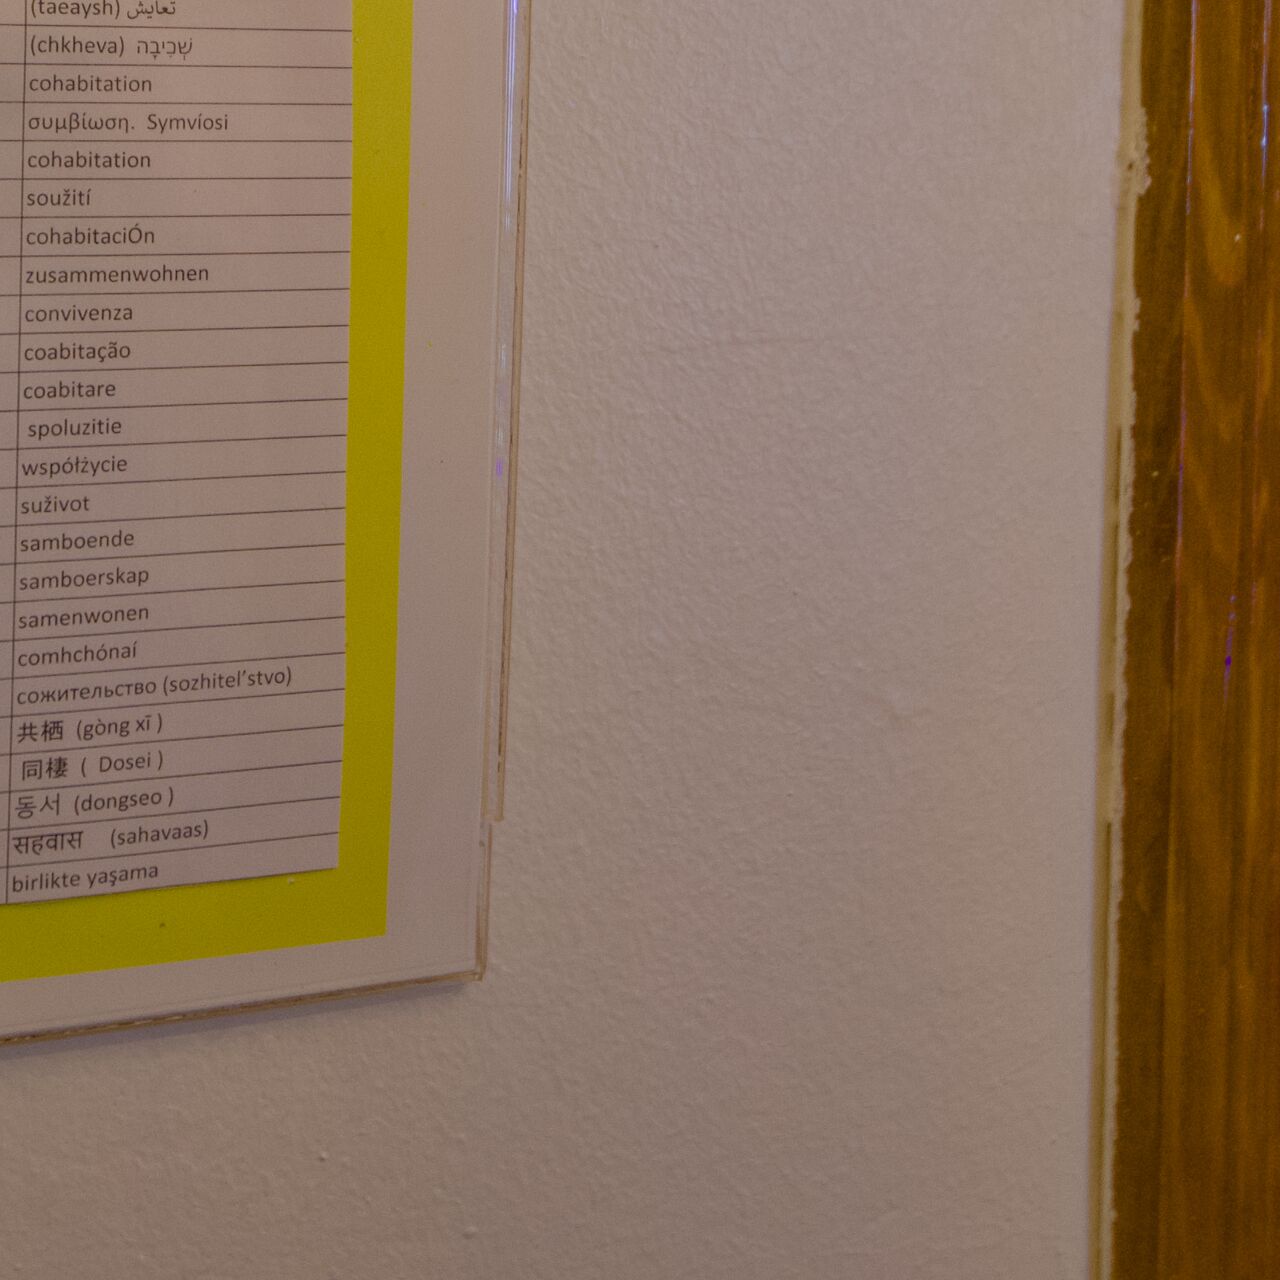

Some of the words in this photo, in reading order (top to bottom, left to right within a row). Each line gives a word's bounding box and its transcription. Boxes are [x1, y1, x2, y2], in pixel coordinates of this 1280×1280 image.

[127, 0, 175, 19] تعايش
[31, 35, 124, 57] (chkheva)
[30, 74, 151, 92] cohabitation
[147, 113, 227, 134] Symvíosi
[28, 151, 150, 168] cohabitation
[27, 189, 91, 206] soužití
[27, 224, 154, 245] cohabitaciÓn
[26, 265, 208, 283] zusammenwohnen
[25, 305, 132, 322] convivenza
[25, 342, 130, 363] coabitação
[24, 381, 115, 399] coabitare
[28, 418, 121, 440] spoluzitie
[22, 456, 127, 478] współżycie
[21, 496, 89, 514] suživot
[21, 530, 134, 552] samboende
[20, 567, 149, 590] samboerskap
[19, 608, 148, 629] samenwonen
[18, 641, 137, 666] comhchónaí
[17, 681, 157, 704] сожительство
[22, 757, 67, 781] 同棲
[100, 752, 150, 772] Dosei
[15, 793, 60, 819] 동서
[12, 831, 83, 855] सहवास
[110, 820, 209, 848] (sahavaas)
[13, 872, 80, 892] birlikte
[86, 865, 158, 888] yaşama
